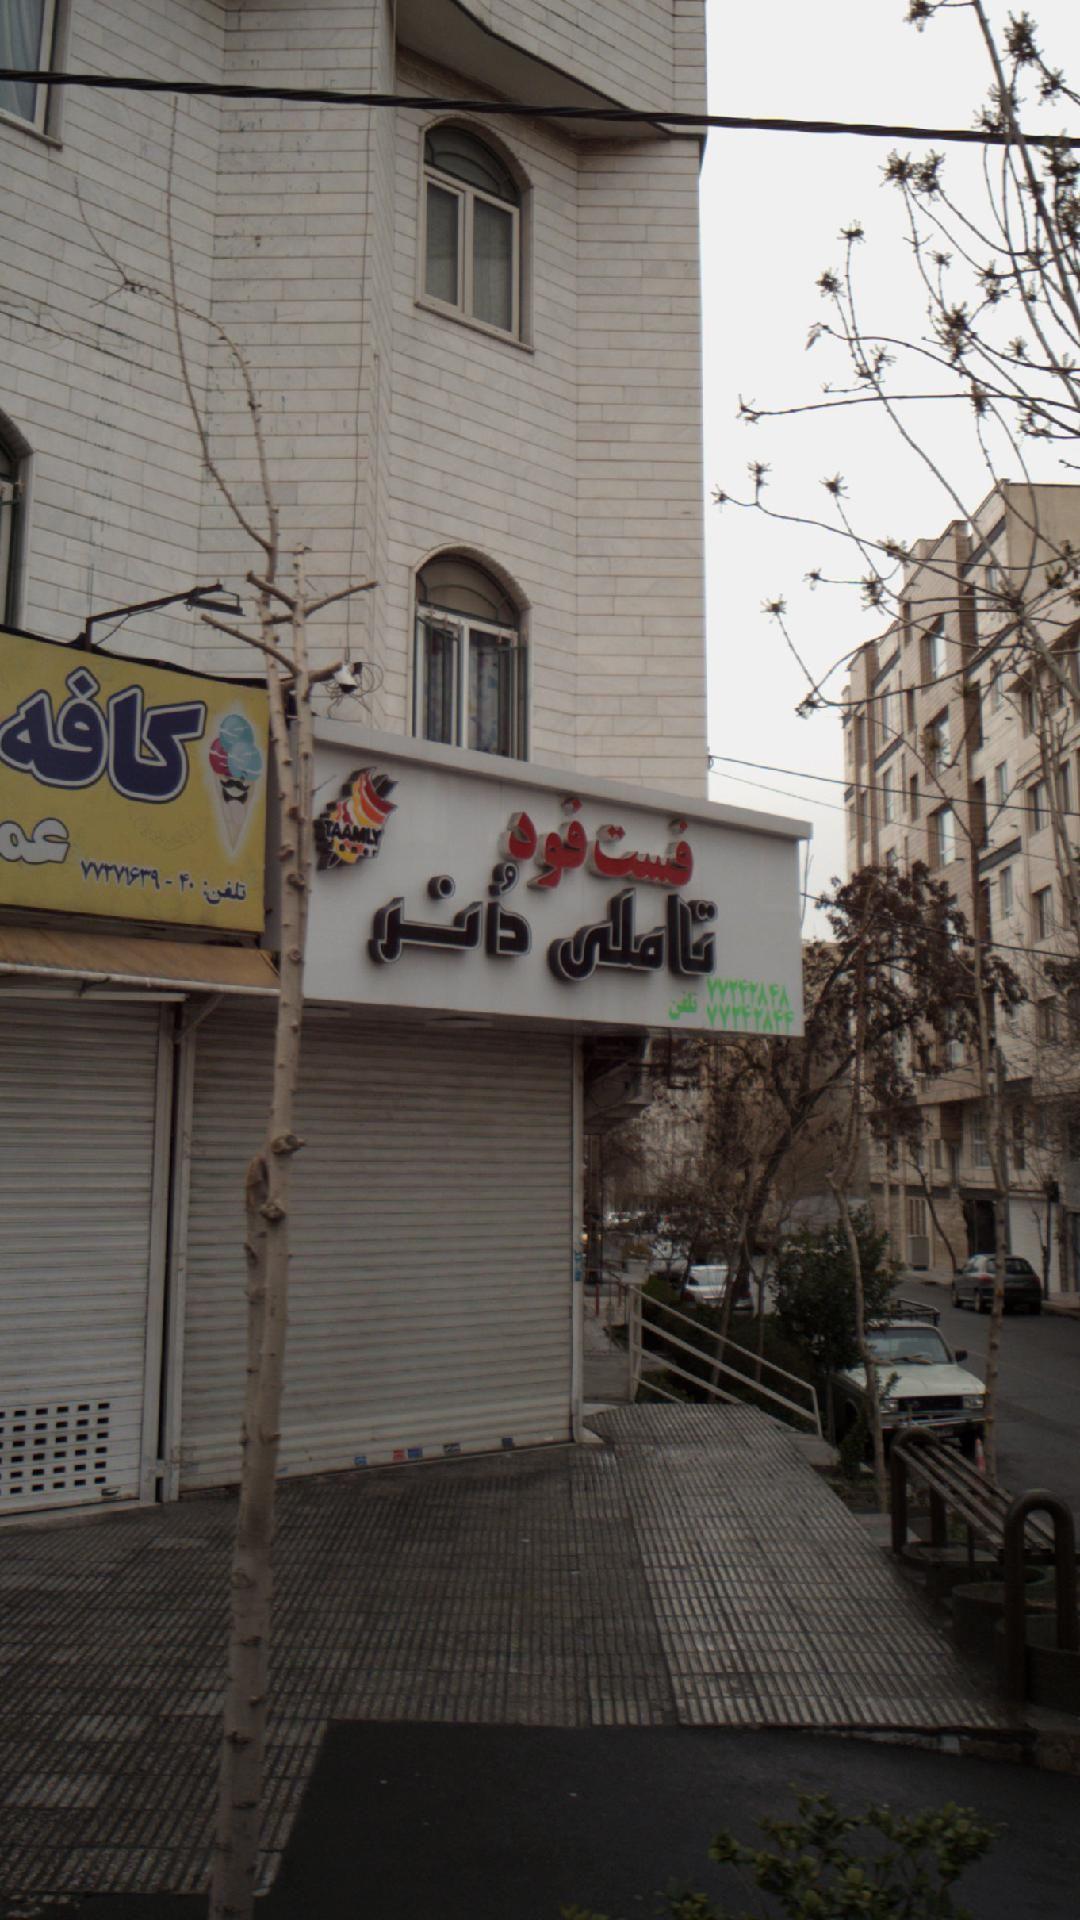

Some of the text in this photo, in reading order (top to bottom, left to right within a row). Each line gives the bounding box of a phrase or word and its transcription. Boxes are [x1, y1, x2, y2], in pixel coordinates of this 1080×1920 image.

[0, 666, 206, 804] کافه
[504, 799, 694, 890] فست فود
